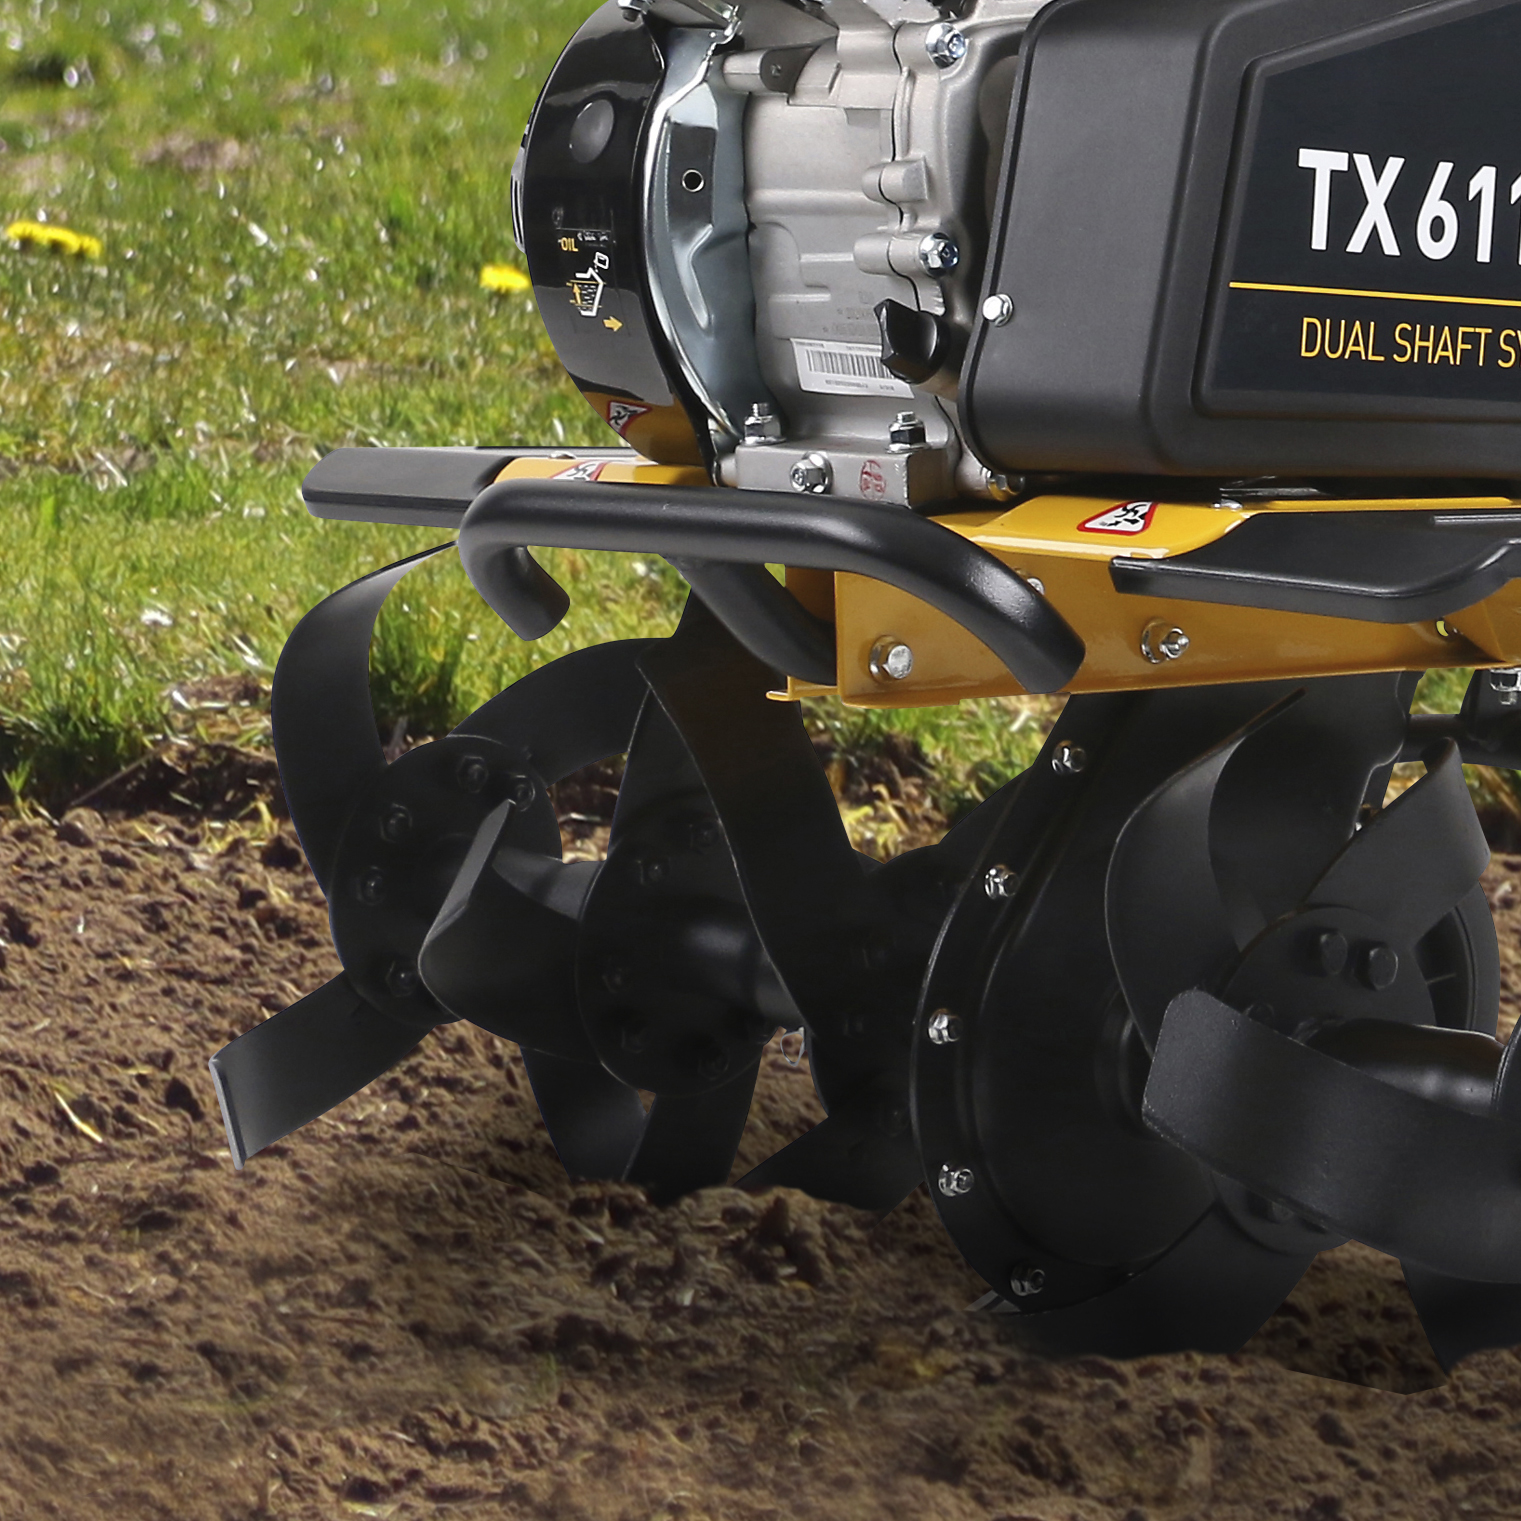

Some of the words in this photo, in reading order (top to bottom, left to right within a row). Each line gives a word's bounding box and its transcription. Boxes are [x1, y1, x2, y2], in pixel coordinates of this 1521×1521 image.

[1298, 147, 1405, 257] TX
[561, 237, 579, 252] OIL
[1300, 316, 1385, 362] DUAL
[1392, 322, 1493, 367] SHAFT
